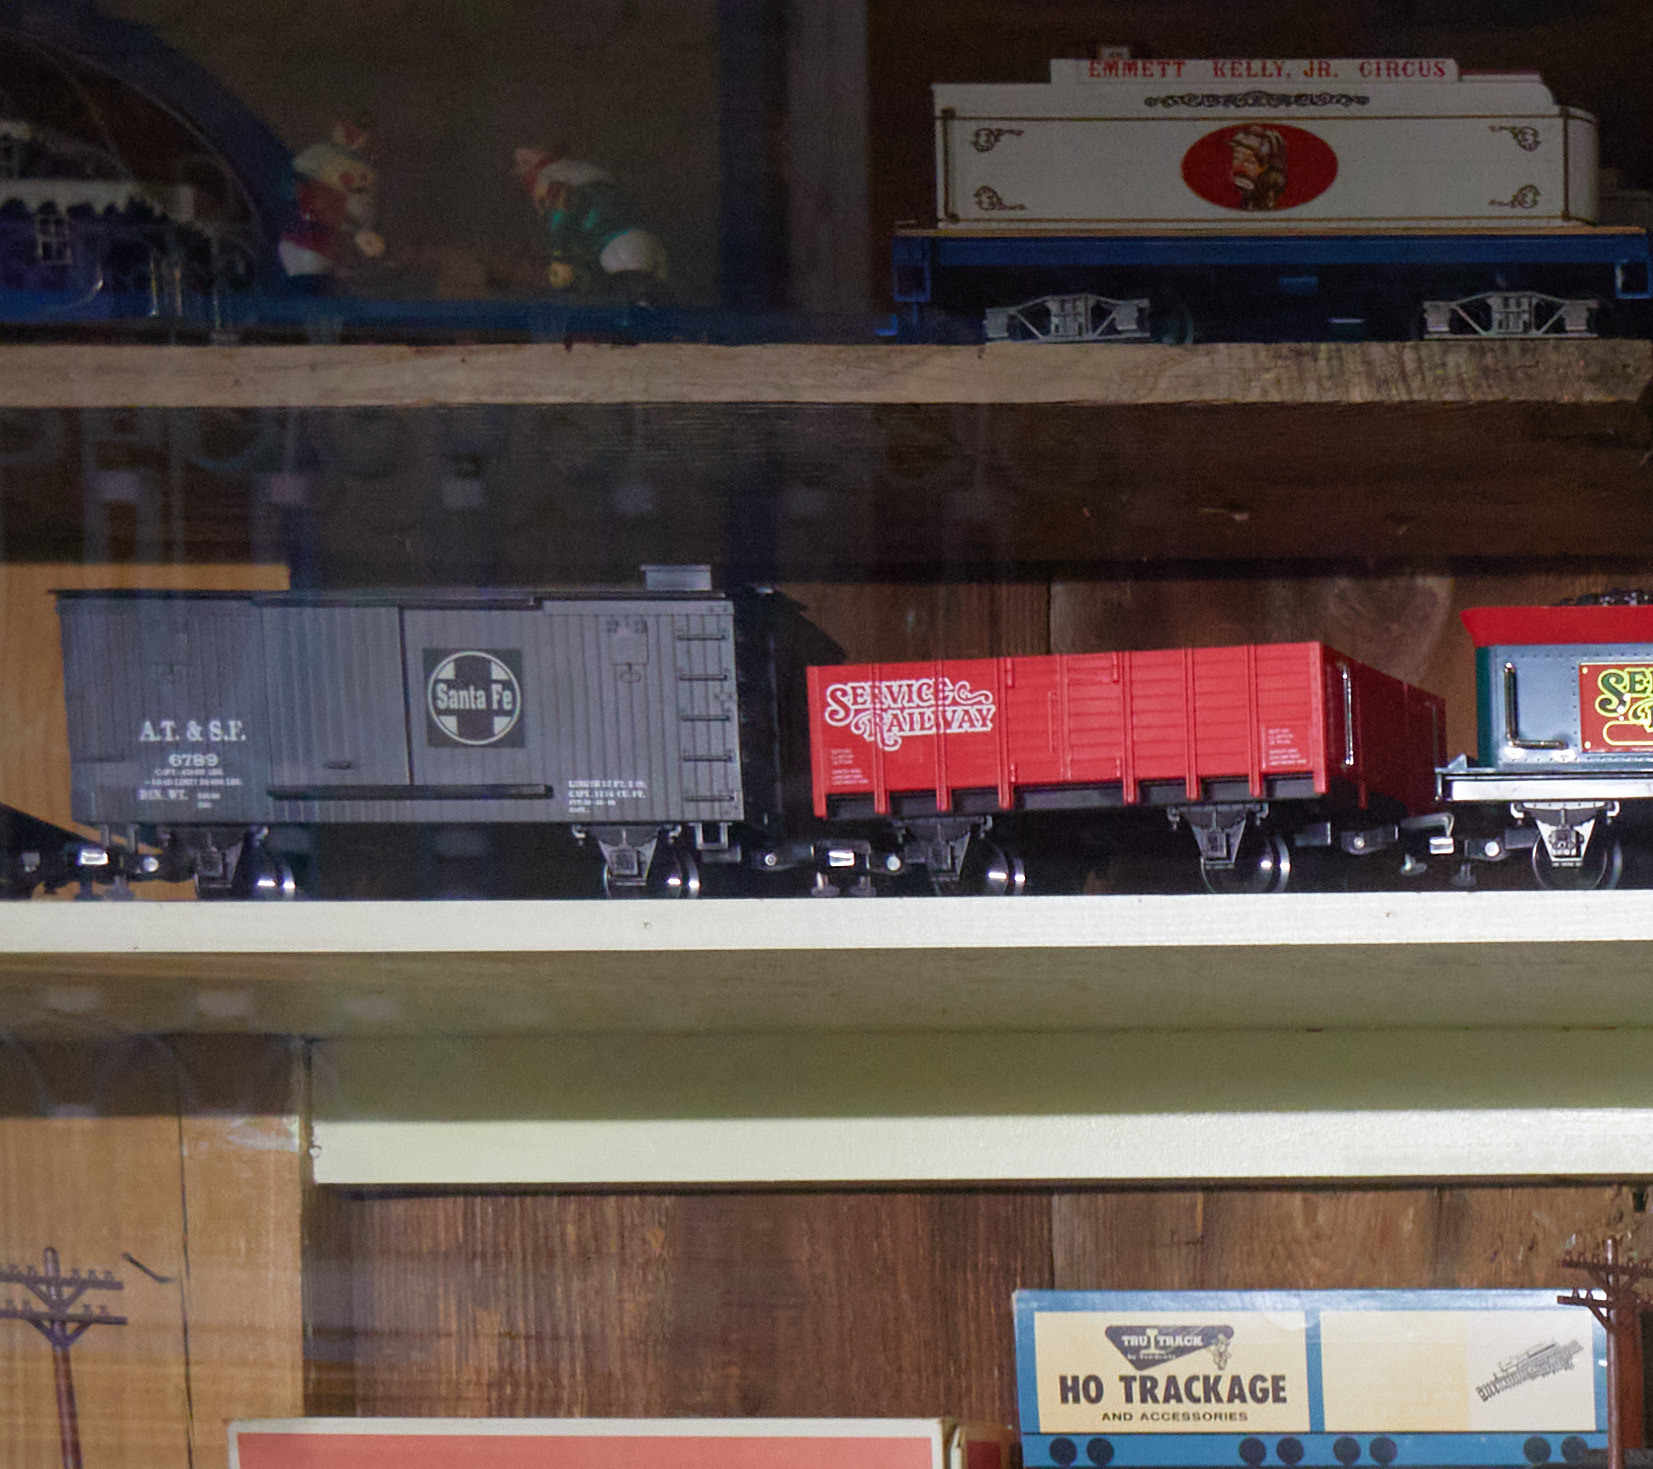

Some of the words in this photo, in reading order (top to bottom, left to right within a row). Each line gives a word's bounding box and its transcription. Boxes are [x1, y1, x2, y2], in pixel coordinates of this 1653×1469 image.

[1087, 59, 1187, 79] EMMETT
[1212, 59, 1291, 80] KELLY,
[1303, 60, 1341, 79] JR.
[1358, 59, 1447, 79] CIRCUS
[436, 683, 487, 710] Santa
[491, 683, 514, 710] Fe
[825, 677, 955, 726] SERVICE
[139, 720, 180, 741] A.T.
[187, 720, 204, 741] &
[209, 720, 247, 741] S.F.
[851, 703, 995, 751] RAILWAY
[168, 754, 219, 767] 6789
[1122, 1335, 1148, 1347] TRU
[1157, 1335, 1204, 1347] TRACK
[1059, 1374, 1104, 1405] HO
[1118, 1374, 1288, 1405] TRACKAGE
[1102, 1412, 1134, 1422] AND
[1139, 1411, 1249, 1422] ACCESSORIES
